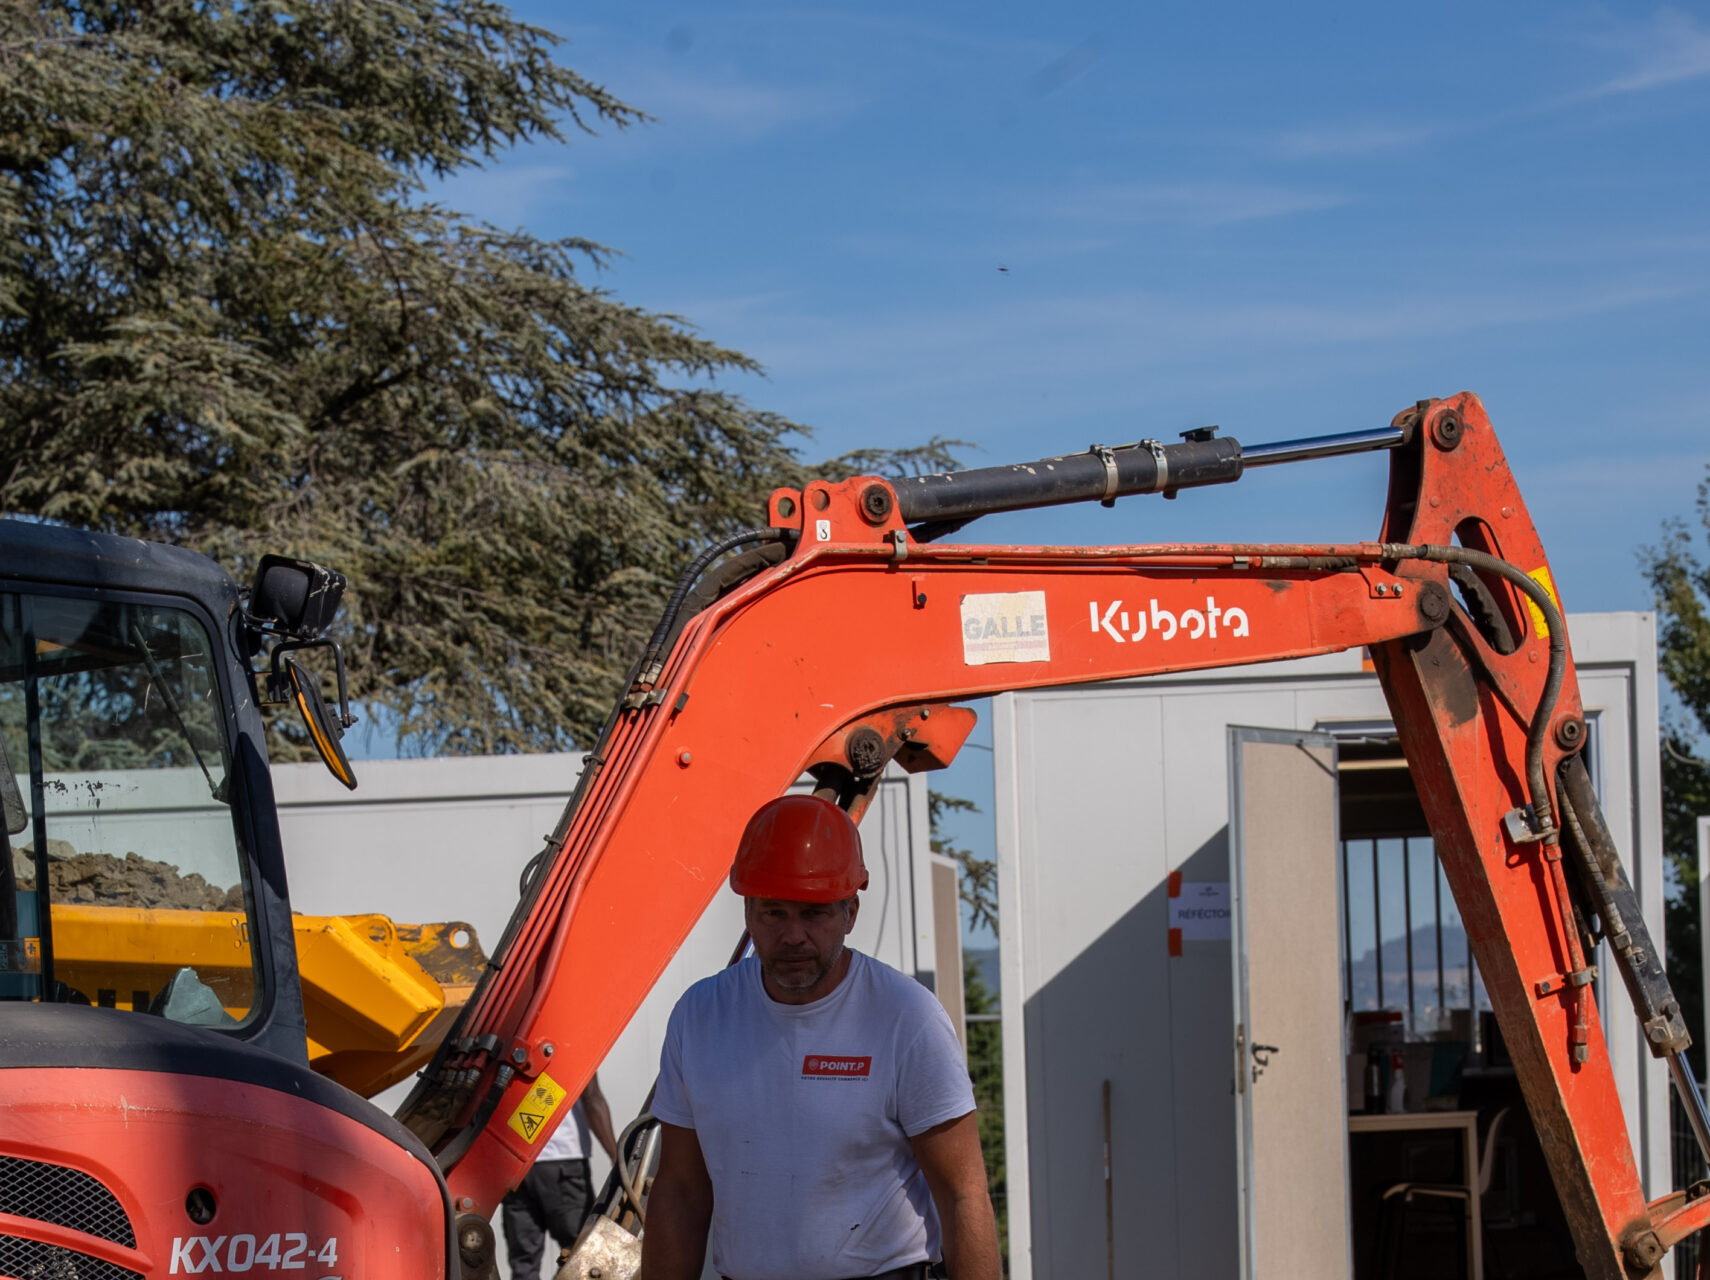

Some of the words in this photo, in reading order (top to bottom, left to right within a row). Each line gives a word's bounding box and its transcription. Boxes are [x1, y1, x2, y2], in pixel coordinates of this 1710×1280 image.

[963, 615, 1046, 640] GALLE
[1089, 596, 1249, 643] Kubota
[1178, 905, 1230, 920] RÉFÉCTOI
[819, 1060, 865, 1071] POINT.P
[169, 1232, 338, 1275] KX042-4
